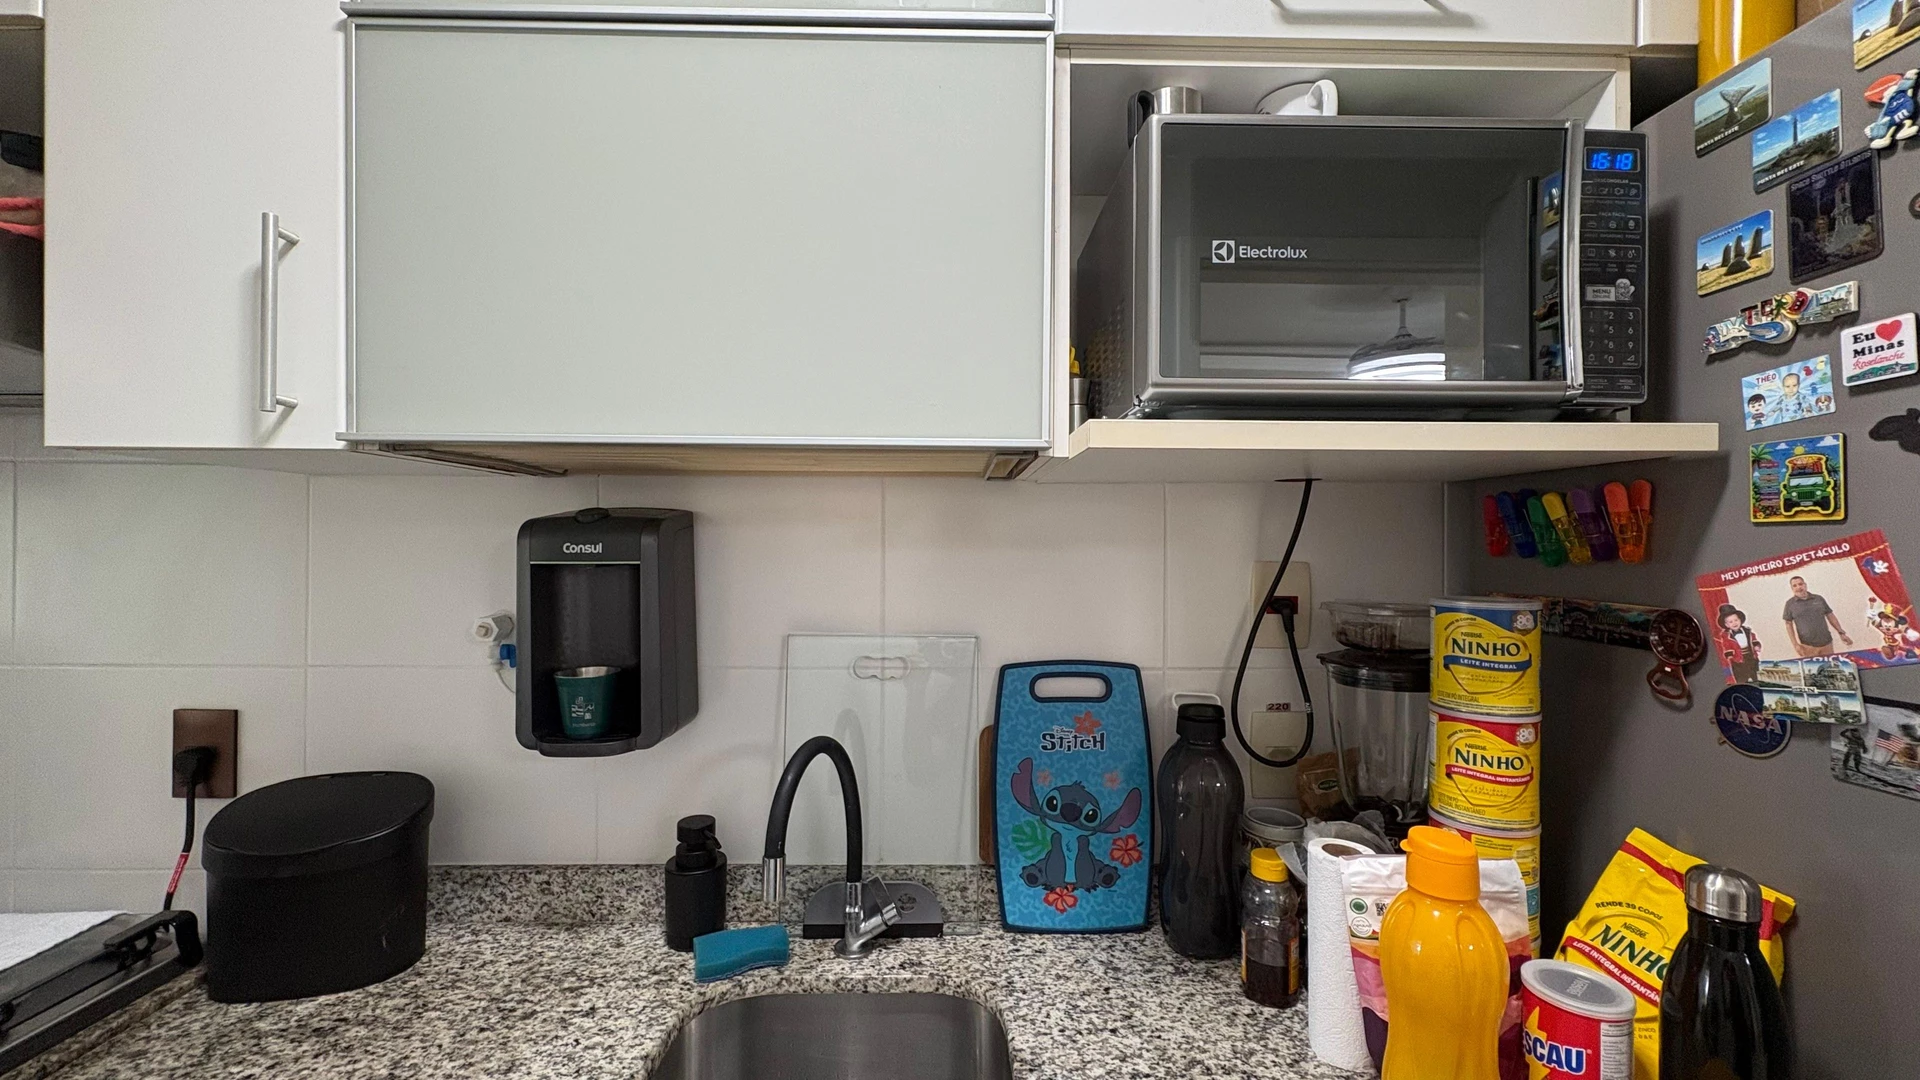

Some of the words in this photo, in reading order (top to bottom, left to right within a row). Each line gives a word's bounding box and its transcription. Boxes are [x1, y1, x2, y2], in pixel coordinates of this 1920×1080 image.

[1239, 246, 1308, 258] Electrolux
[1852, 332, 1876, 344] Eu
[1853, 340, 1905, 359] Minas
[563, 542, 603, 554] Consul
[1721, 570, 1740, 581] MEU
[1740, 560, 1783, 576] PRIMEIRO
[1783, 542, 1850, 566] ESPETÁCULO
[1451, 637, 1521, 657] NINHO
[1460, 658, 1480, 666] LEITE
[1481, 661, 1517, 669] INTEGRAL
[1267, 703, 1289, 711] 220
[1719, 705, 1783, 735] NASA
[1454, 747, 1524, 770] NINHO
[1451, 766, 1466, 775] LEITE
[1466, 769, 1496, 781] INTEGRAL
[1595, 901, 1624, 909] RENDE
[1637, 906, 1664, 921] COPOS
[1620, 922, 1650, 939] Nestlé
[1573, 940, 1592, 953] LEITE
[1590, 949, 1621, 976] INTEGRAL
[1620, 971, 1660, 1003] INSTANTÂN
[1523, 1028, 1586, 1075] SCAU
